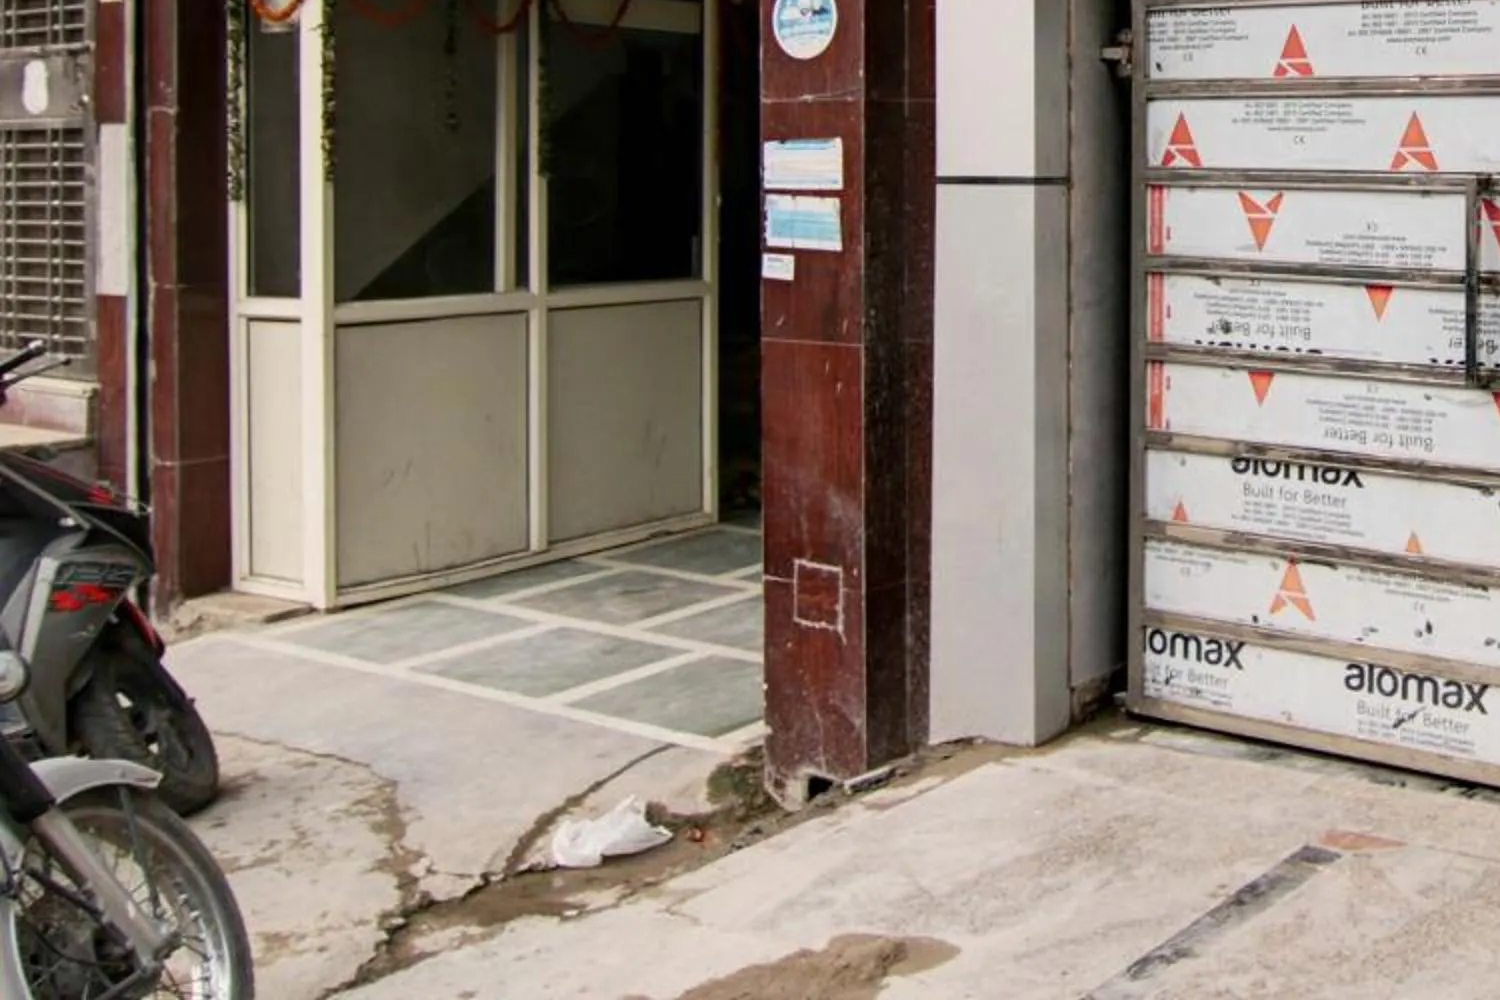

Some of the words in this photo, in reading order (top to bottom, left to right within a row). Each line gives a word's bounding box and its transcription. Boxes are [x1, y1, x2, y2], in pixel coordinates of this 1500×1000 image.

[1324, 427, 1367, 445] Better
[1373, 431, 1394, 449] for
[1399, 434, 1434, 452] Built
[1244, 482, 1274, 498] Built
[1279, 486, 1299, 502] for
[1303, 489, 1347, 508] Better
[1344, 662, 1489, 715] alomax
[1356, 700, 1390, 717] Built
[1423, 711, 1470, 734] Better
